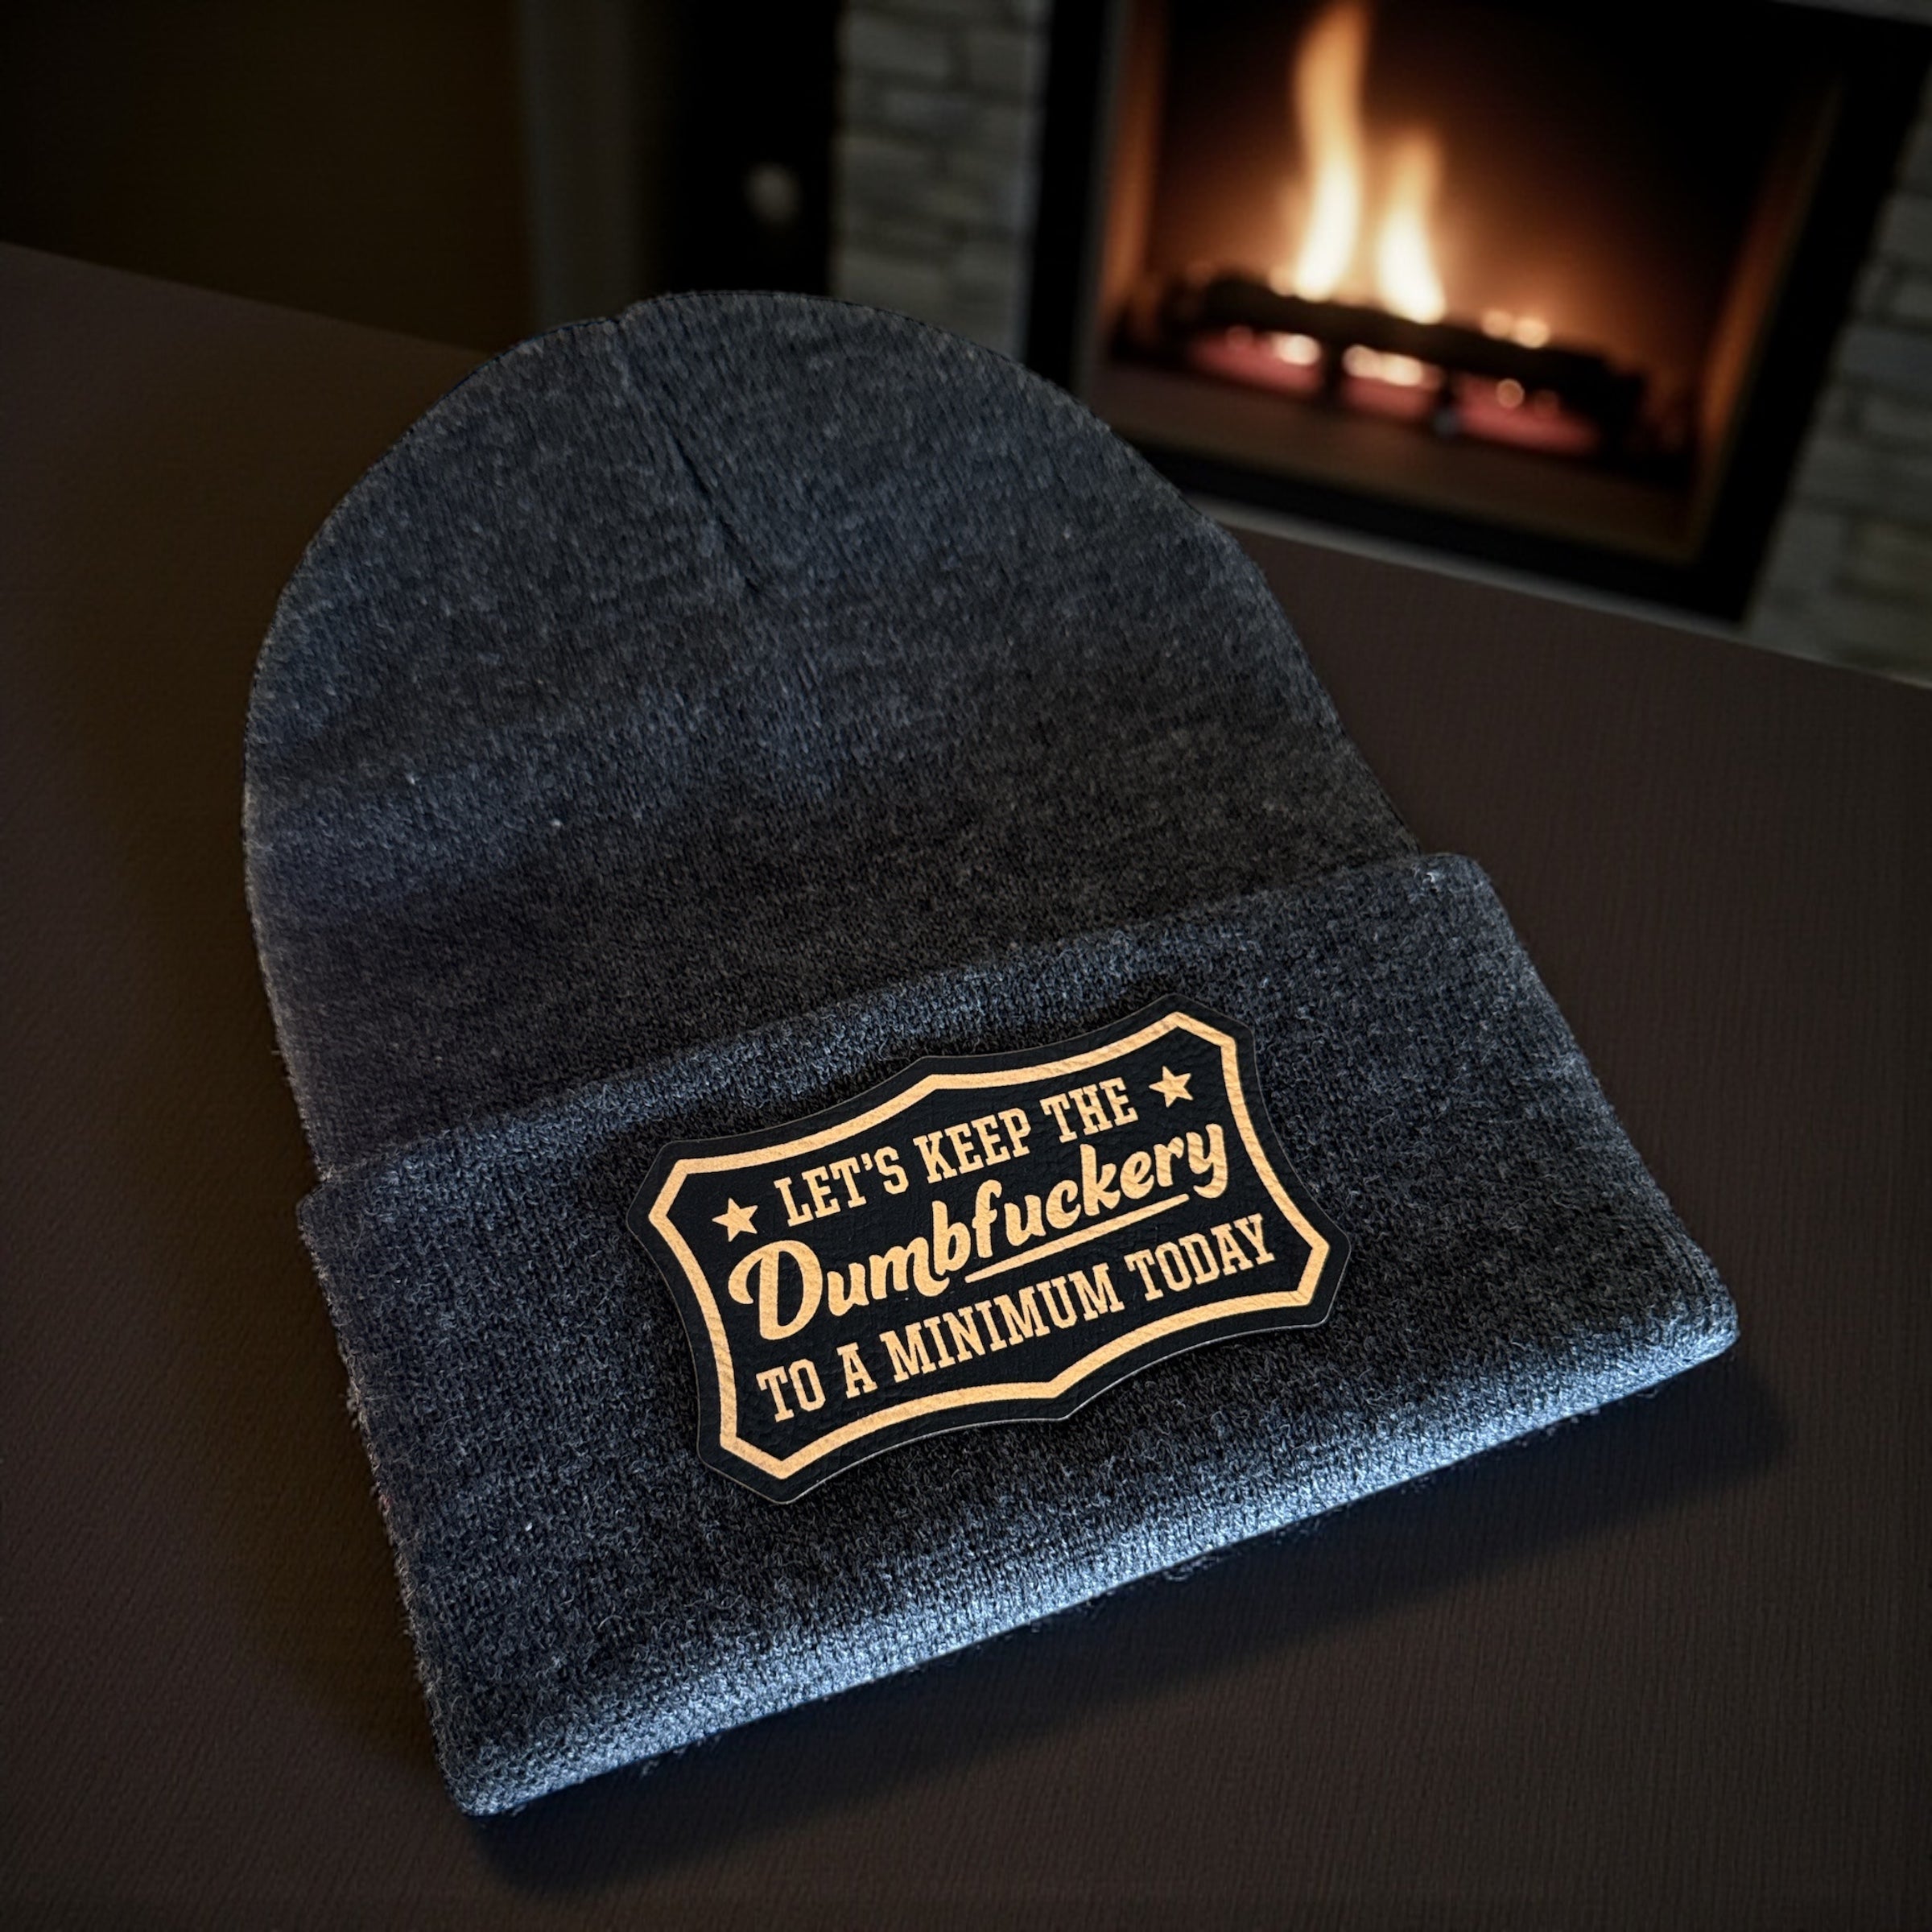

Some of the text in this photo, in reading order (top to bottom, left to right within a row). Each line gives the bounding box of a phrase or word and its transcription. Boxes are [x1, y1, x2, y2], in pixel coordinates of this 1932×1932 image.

[728, 1123, 1228, 1340] Dumbfuckery
[774, 1077, 1138, 1227] LET'S KEEP THE
[756, 1213, 1275, 1422] TO A MINIMUM TODAY
